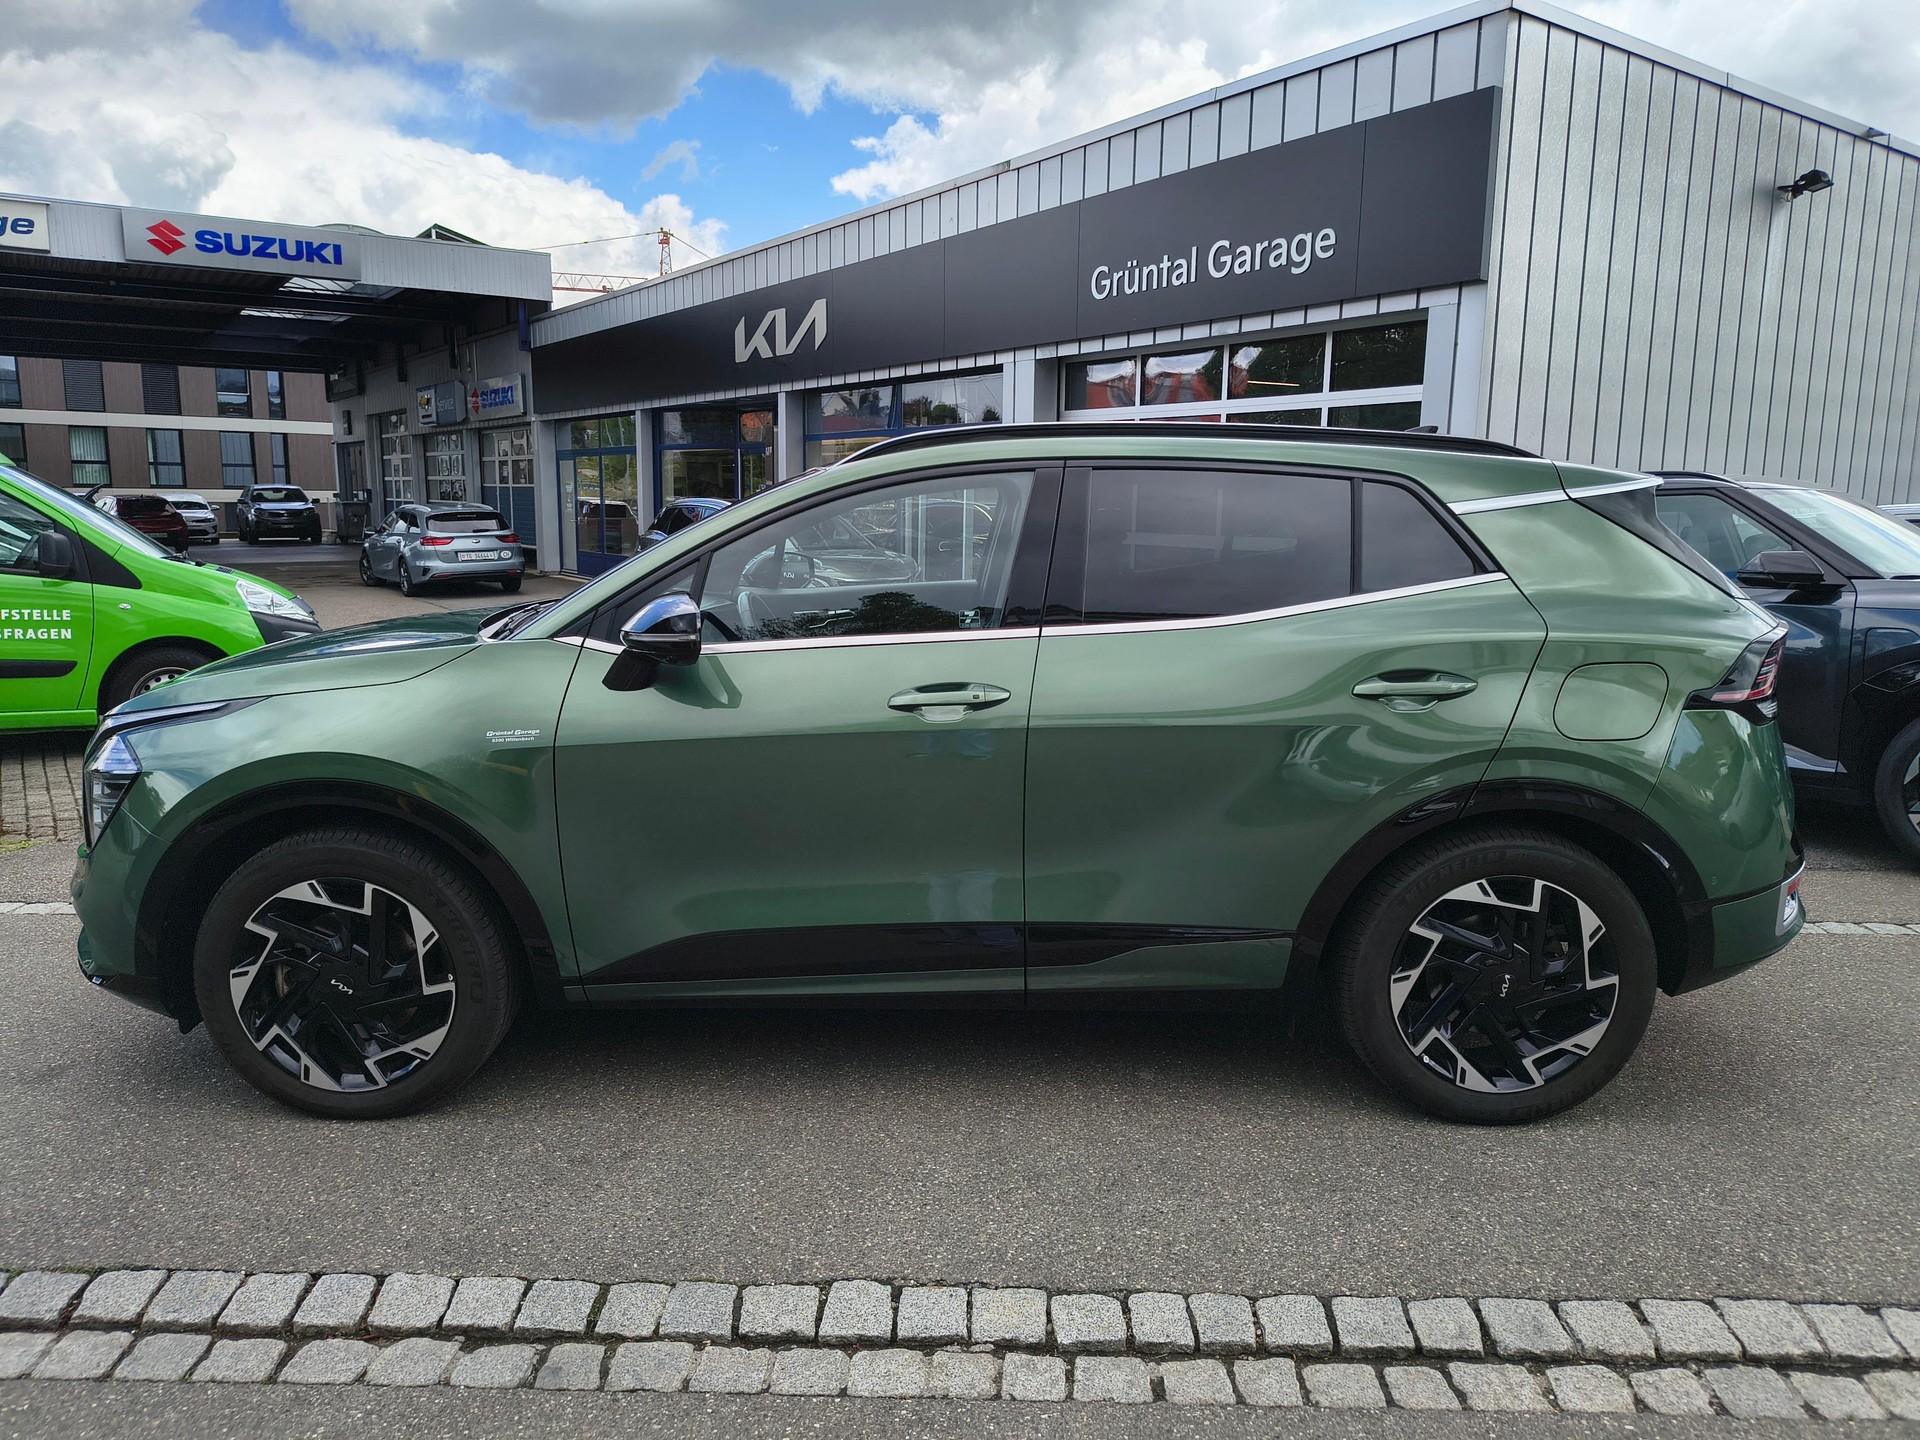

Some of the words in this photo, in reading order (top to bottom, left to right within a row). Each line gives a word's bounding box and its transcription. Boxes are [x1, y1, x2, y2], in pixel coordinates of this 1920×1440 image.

[194, 229, 343, 265] SUZUKI
[1091, 246, 1198, 300] Grüntal
[1207, 227, 1337, 279] Garage
[437, 395, 455, 412] Service
[480, 385, 515, 409] SUZUKI
[1, 609, 71, 621] FSTELLE
[0, 628, 72, 640] FRAGEN
